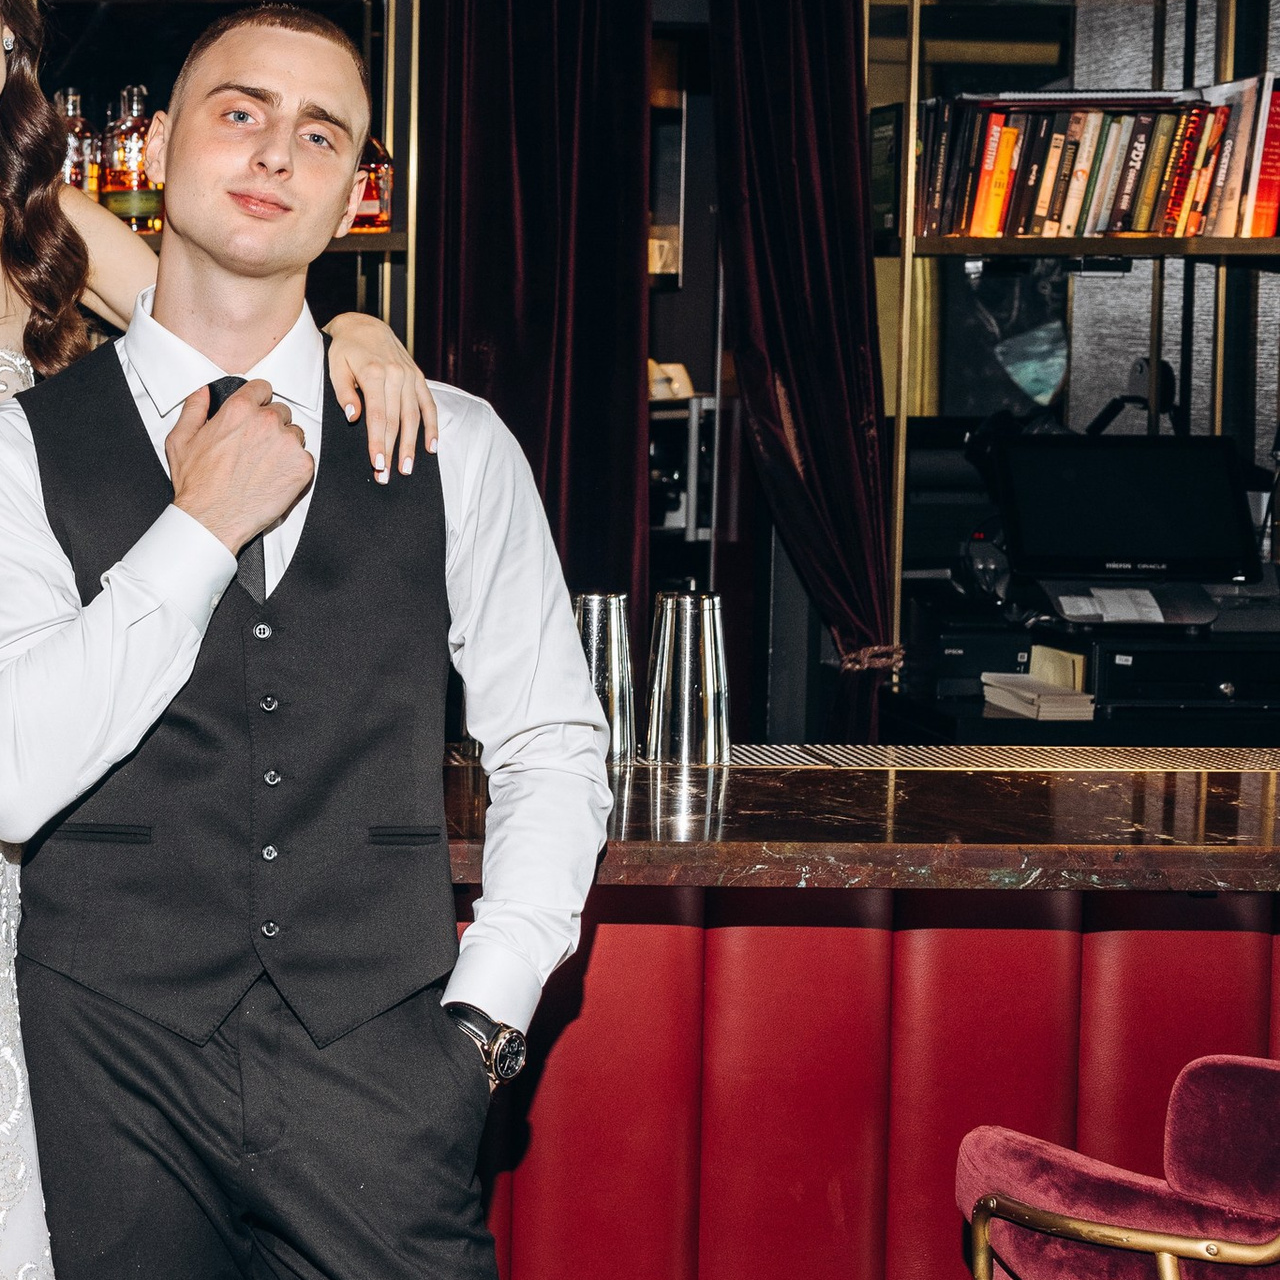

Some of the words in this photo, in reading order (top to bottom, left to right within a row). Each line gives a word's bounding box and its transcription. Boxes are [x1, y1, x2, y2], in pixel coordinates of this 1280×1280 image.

[984, 124, 1001, 171] APERITIVO
[1128, 141, 1147, 171] PDT
[1216, 138, 1234, 188] COCKTAILS
